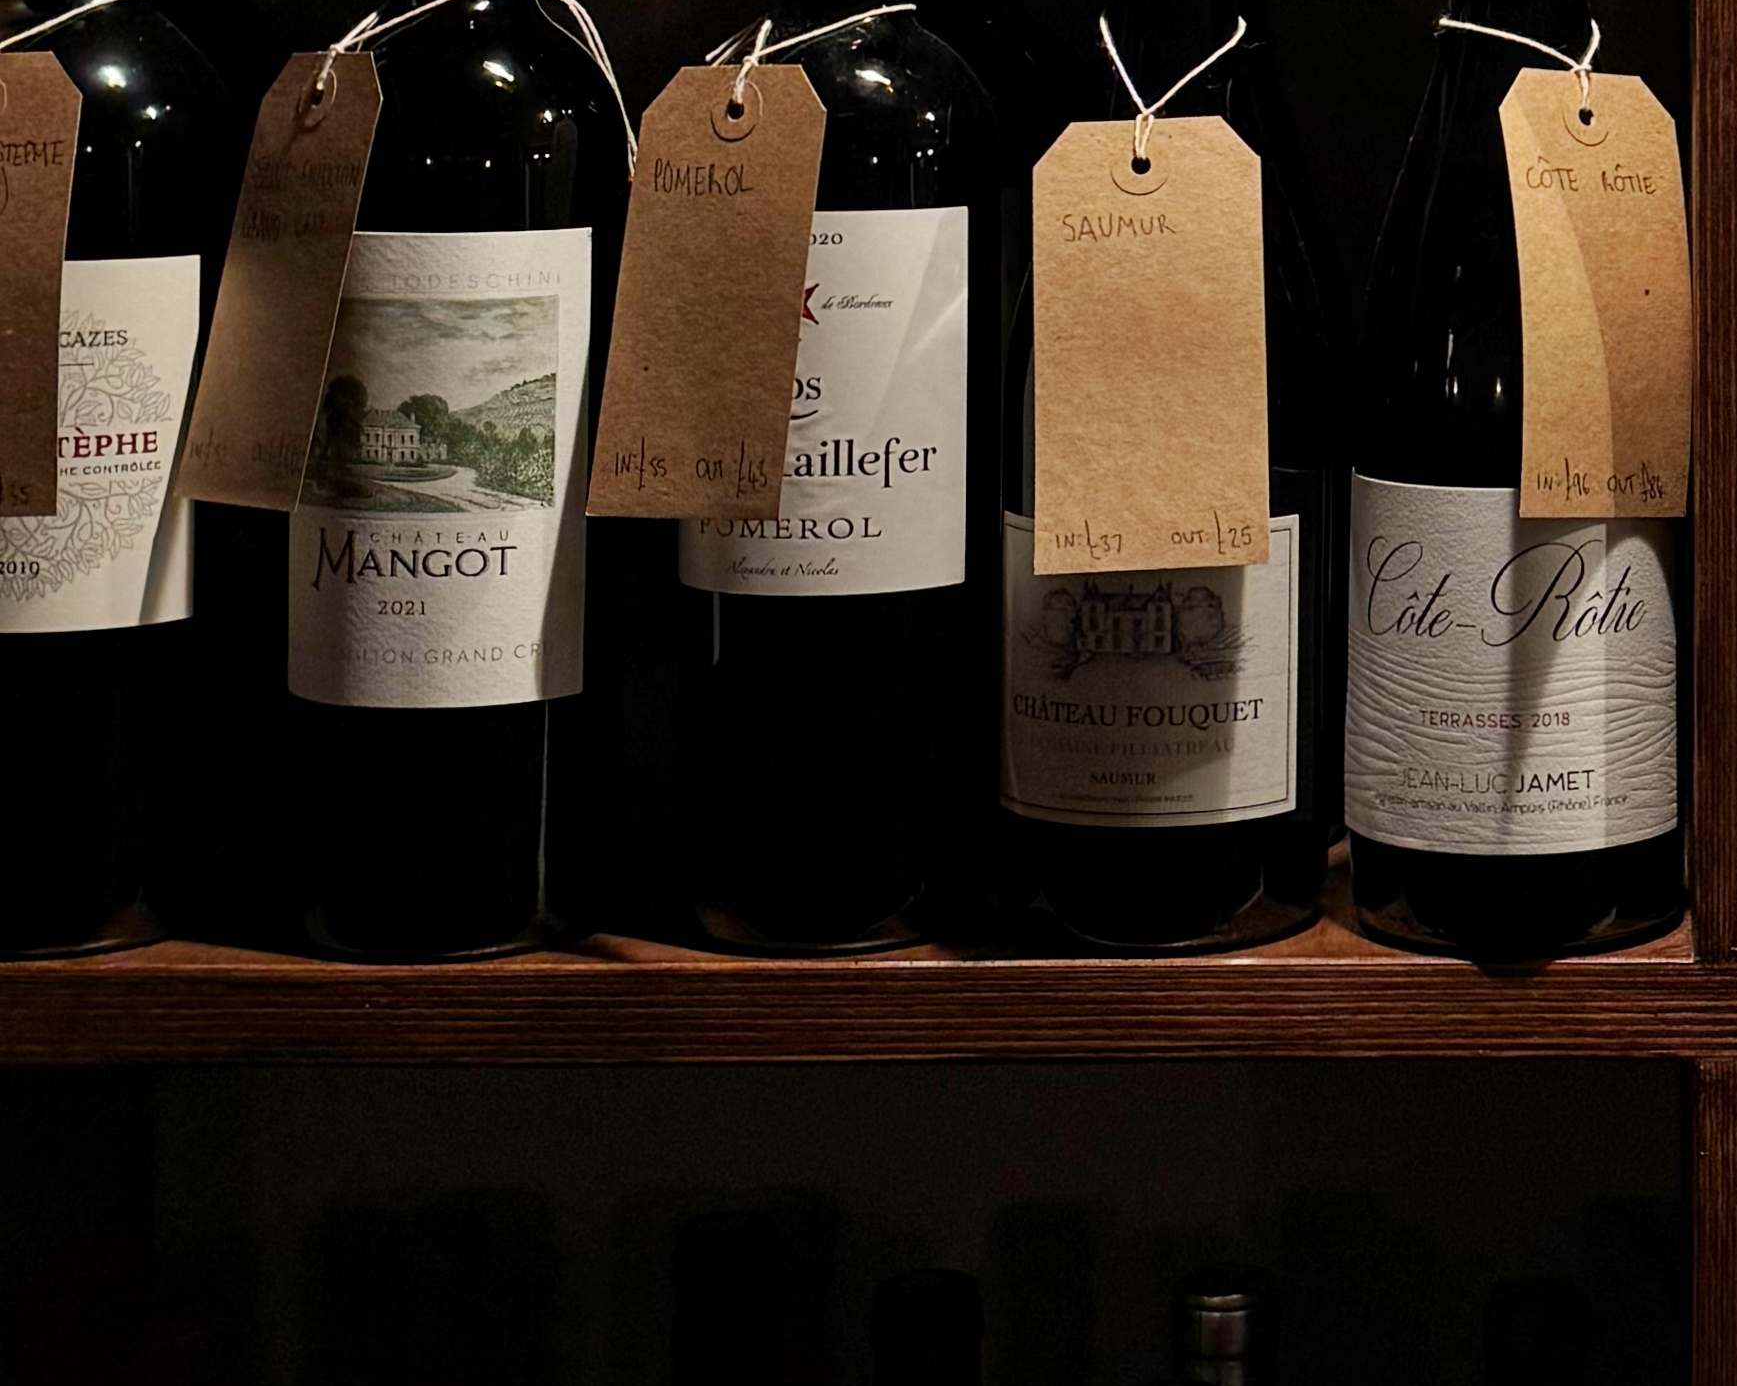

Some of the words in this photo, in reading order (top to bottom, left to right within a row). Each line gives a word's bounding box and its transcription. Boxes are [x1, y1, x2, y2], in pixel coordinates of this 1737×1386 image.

[653, 157, 754, 197] POMEROL
[1526, 155, 1580, 192] CÔTE
[1601, 156, 1657, 196] RÔTIE
[1062, 213, 1177, 243] SAUMUR
[83, 459, 163, 476] CONTRÔLÉE
[784, 436, 938, 490] aillefer
[368, 528, 511, 545] CHÂTEAU
[311, 527, 518, 591] MANGOT
[377, 599, 427, 617] 2021
[424, 645, 504, 667] GRAND
[1127, 698, 1264, 730] FOUQUET
[1419, 709, 1521, 729] TERRASSES
[1531, 711, 1571, 728] 2018
[1400, 768, 1508, 794] JEAN-LUC
[1515, 769, 1596, 794] JAMET
